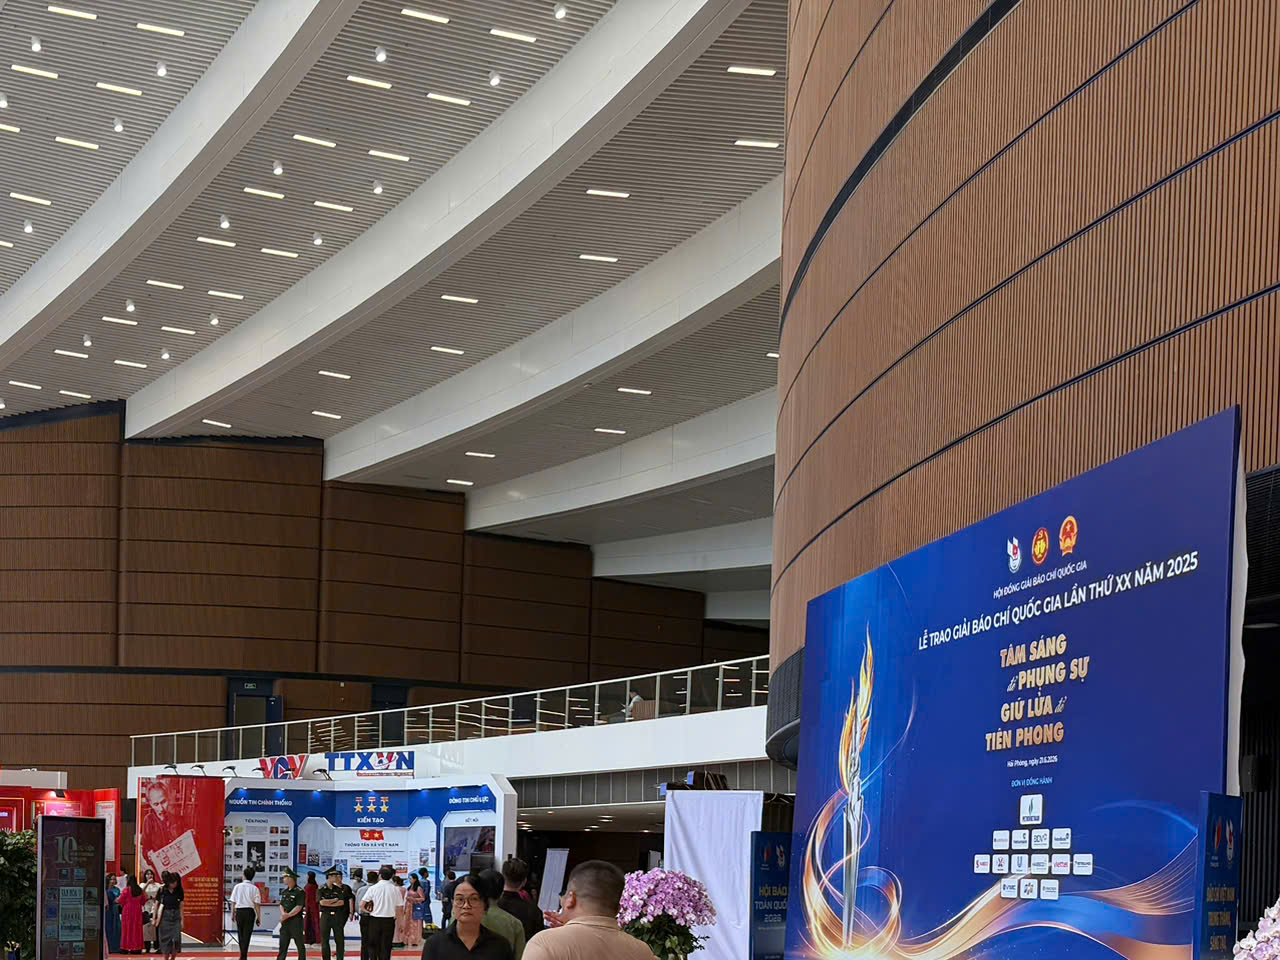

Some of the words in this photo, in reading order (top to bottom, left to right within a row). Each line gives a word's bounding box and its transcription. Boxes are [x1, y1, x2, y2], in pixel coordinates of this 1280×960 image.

[993, 588, 1004, 599] HỘI
[1003, 584, 1020, 597] ĐỒNG
[1020, 577, 1032, 592] GIẢI
[1032, 573, 1046, 589] BÁO
[1046, 570, 1056, 586] CHÍ
[1057, 564, 1076, 584] QUỐC
[1076, 560, 1087, 573] GIA
[918, 629, 929, 650] LỄ
[928, 626, 951, 647] TRAO
[952, 617, 971, 641] GIẢI
[972, 614, 992, 635] BÁO
[993, 607, 1011, 629] CHÍ
[1011, 599, 1042, 625] QUỐC
[1043, 597, 1062, 617] GIA
[1064, 582, 1087, 608] LẦN
[1088, 574, 1114, 601] THỨ
[1114, 574, 1132, 592] XX
[1133, 561, 1165, 588] NĂM
[1166, 551, 1199, 579] 2025
[1000, 643, 1026, 668] TÂM
[1029, 633, 1067, 661] SÁNG
[1006, 675, 1018, 692] để
[1018, 661, 1066, 691] PHỤNG
[1069, 655, 1090, 683] SỰ
[1027, 691, 1053, 718] LỬA
[985, 727, 1012, 752] TIÊN
[1015, 721, 1064, 748] PHONG
[259, 755, 307, 780] VOV
[324, 751, 415, 771] TTXVN
[357, 816, 371, 824] KIẾN
[372, 817, 385, 825] TẠO
[55, 836, 78, 863] 10
[754, 899, 773, 910] TOÀN
[773, 898, 788, 911] QUỐ
[759, 884, 771, 898] HỘI
[772, 885, 787, 896] BÁO
[764, 913, 782, 923] 2026
